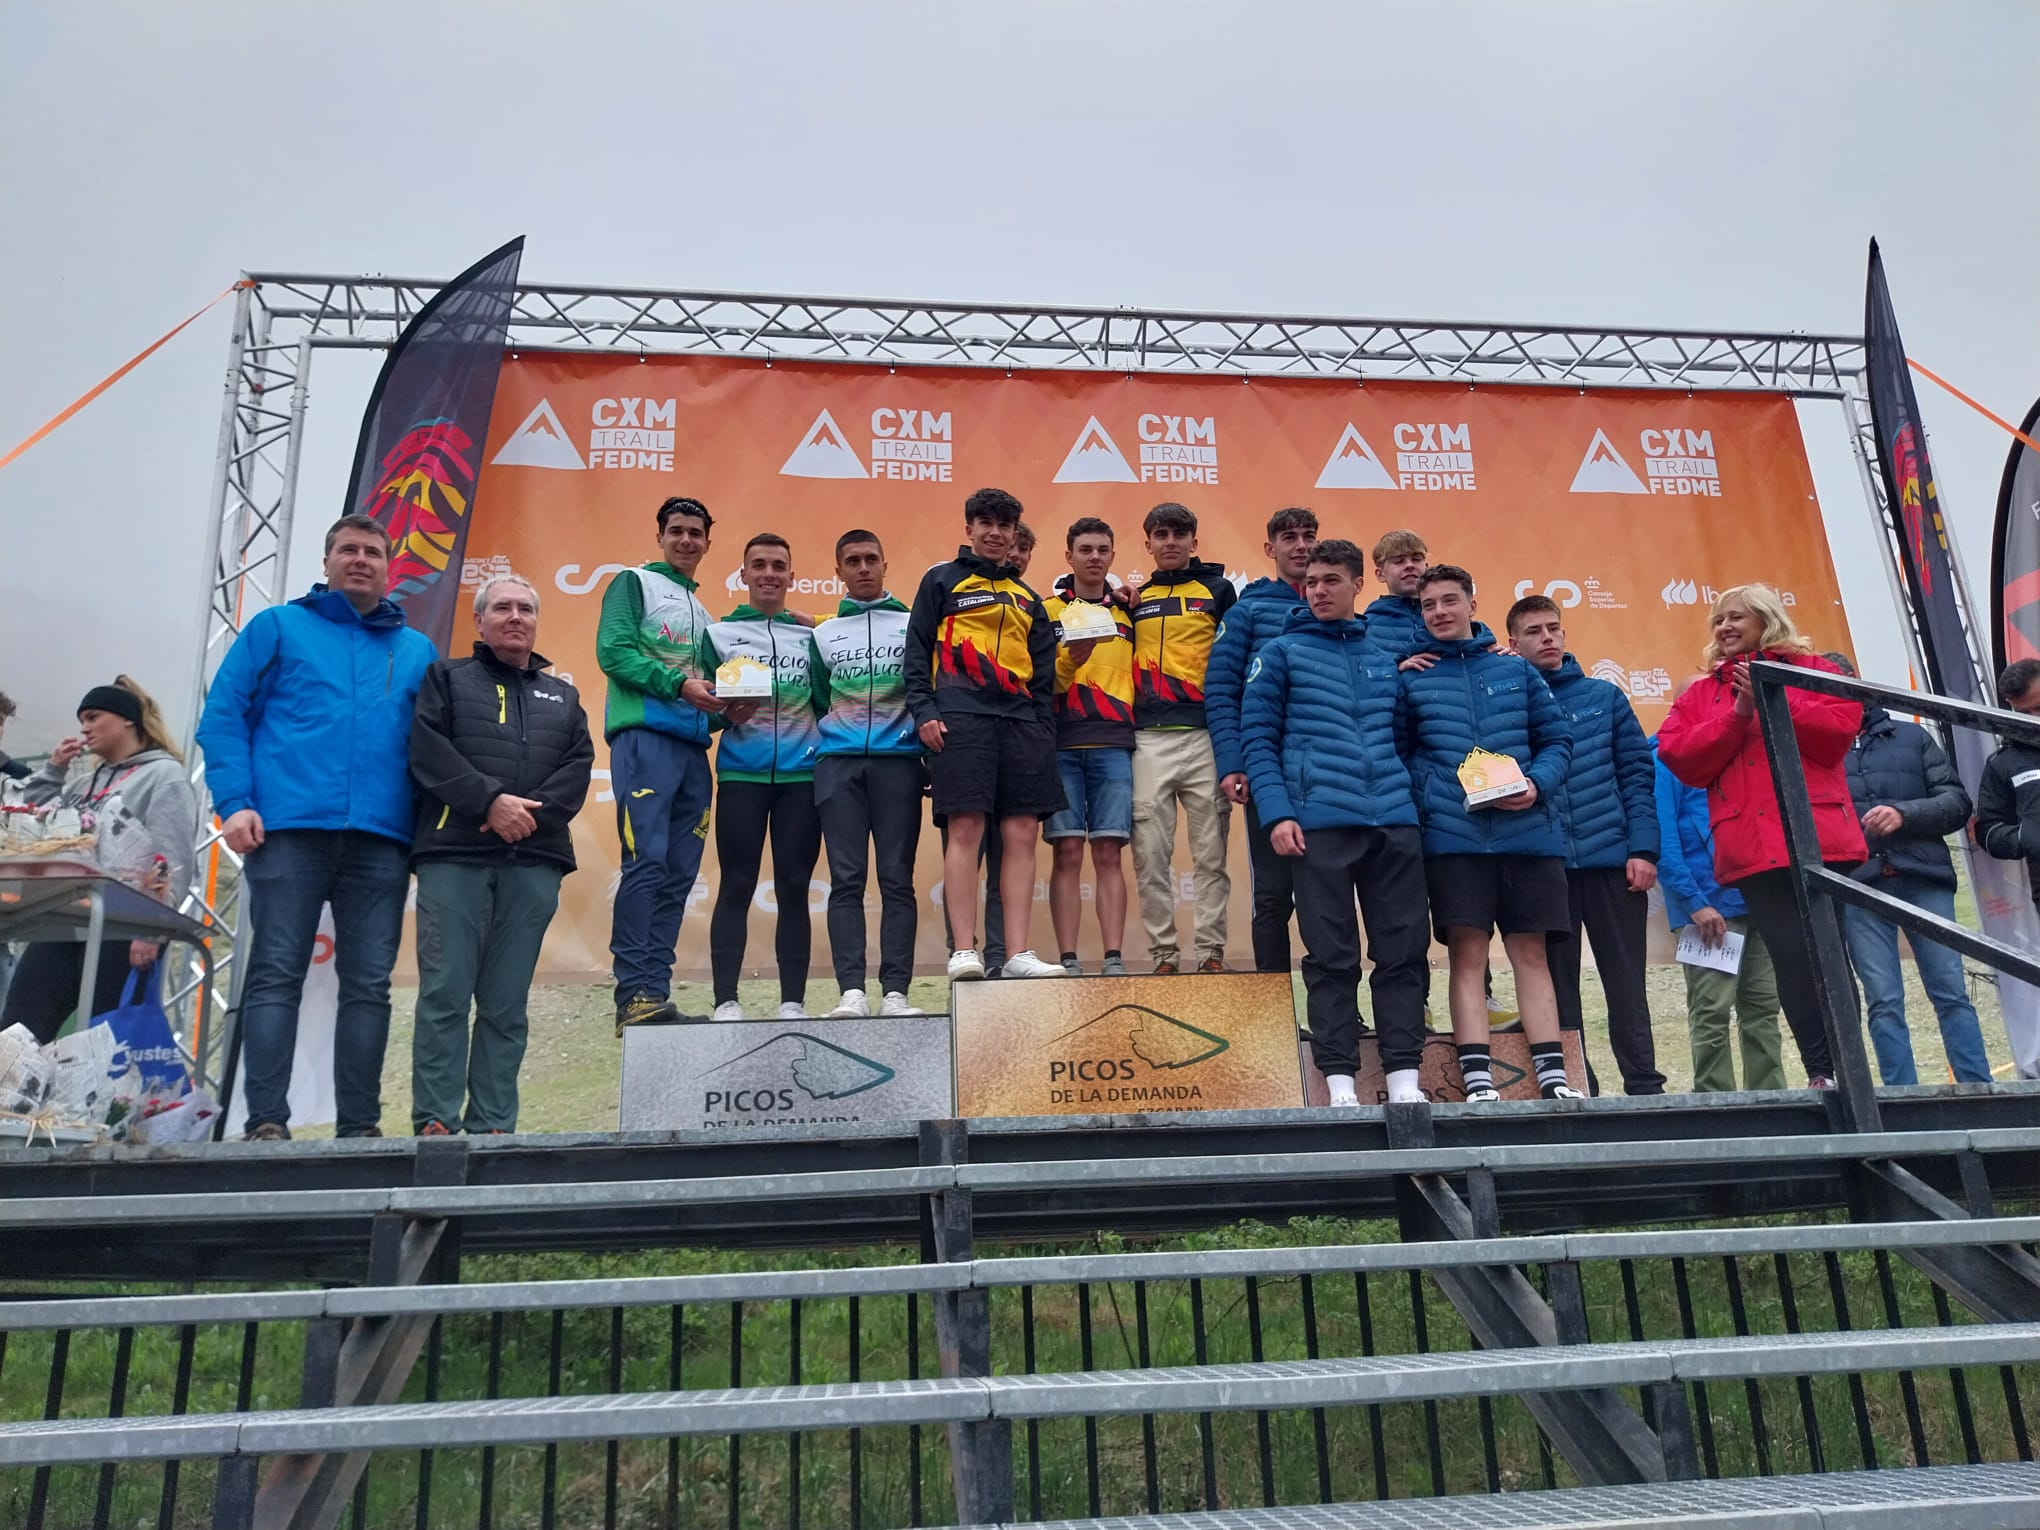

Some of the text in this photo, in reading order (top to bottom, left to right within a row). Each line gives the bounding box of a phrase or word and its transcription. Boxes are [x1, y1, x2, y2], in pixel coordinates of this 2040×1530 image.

[592, 398, 677, 428] CXM
[871, 408, 952, 441] CXM
[1138, 414, 1217, 445] CXM
[598, 431, 668, 449] TRAIL
[1393, 423, 1472, 451] CXM
[1640, 429, 1715, 457] CXM
[880, 441, 945, 460] TRAIL
[1147, 446, 1211, 464] TRAIL
[589, 450, 674, 472] FEDME
[1404, 454, 1468, 470] TRAIL
[1651, 460, 1713, 476] TRAIL
[871, 461, 952, 482] FEDME
[1140, 465, 1219, 485] FEDME
[1398, 473, 1477, 491] FEDME
[1648, 478, 1722, 497] FEDME
[830, 644, 905, 666] SELECCIÓ
[835, 663, 905, 681] ANDALUZ
[1051, 1058, 1135, 1082] PICOS
[704, 1088, 794, 1113] PICOS
[1050, 1085, 1202, 1104] DE LA DEMANDA
